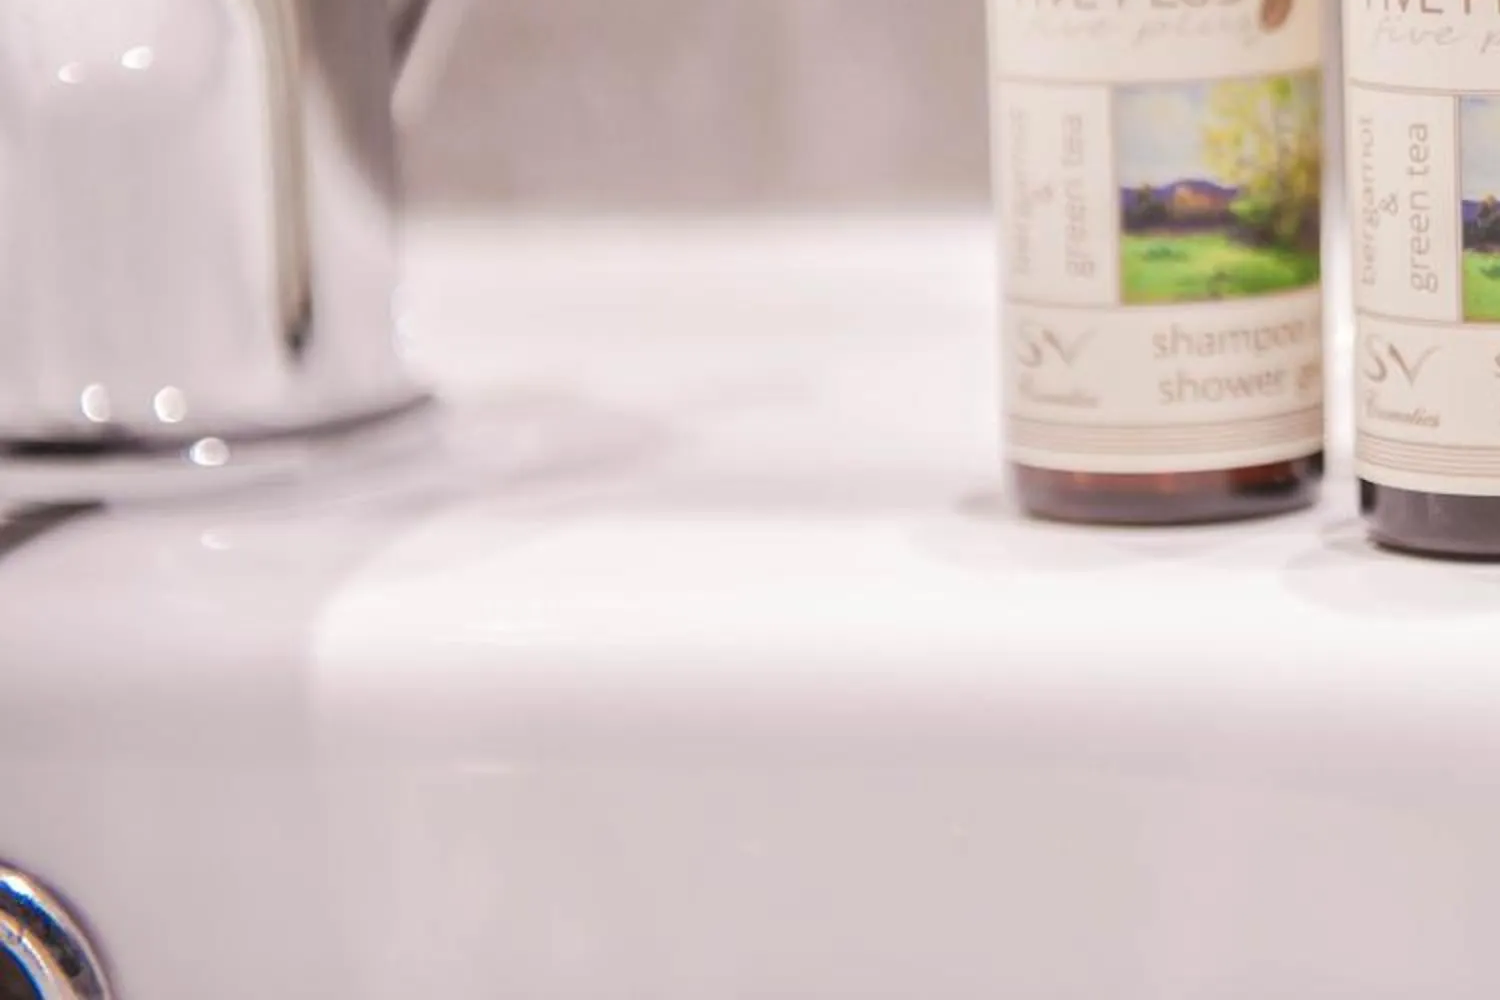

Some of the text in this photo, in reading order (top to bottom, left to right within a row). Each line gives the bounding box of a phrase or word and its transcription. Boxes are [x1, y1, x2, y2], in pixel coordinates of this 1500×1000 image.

[1406, 122, 1439, 295] green tea
[1157, 366, 1288, 406] shower
[1363, 332, 1443, 388] SV
